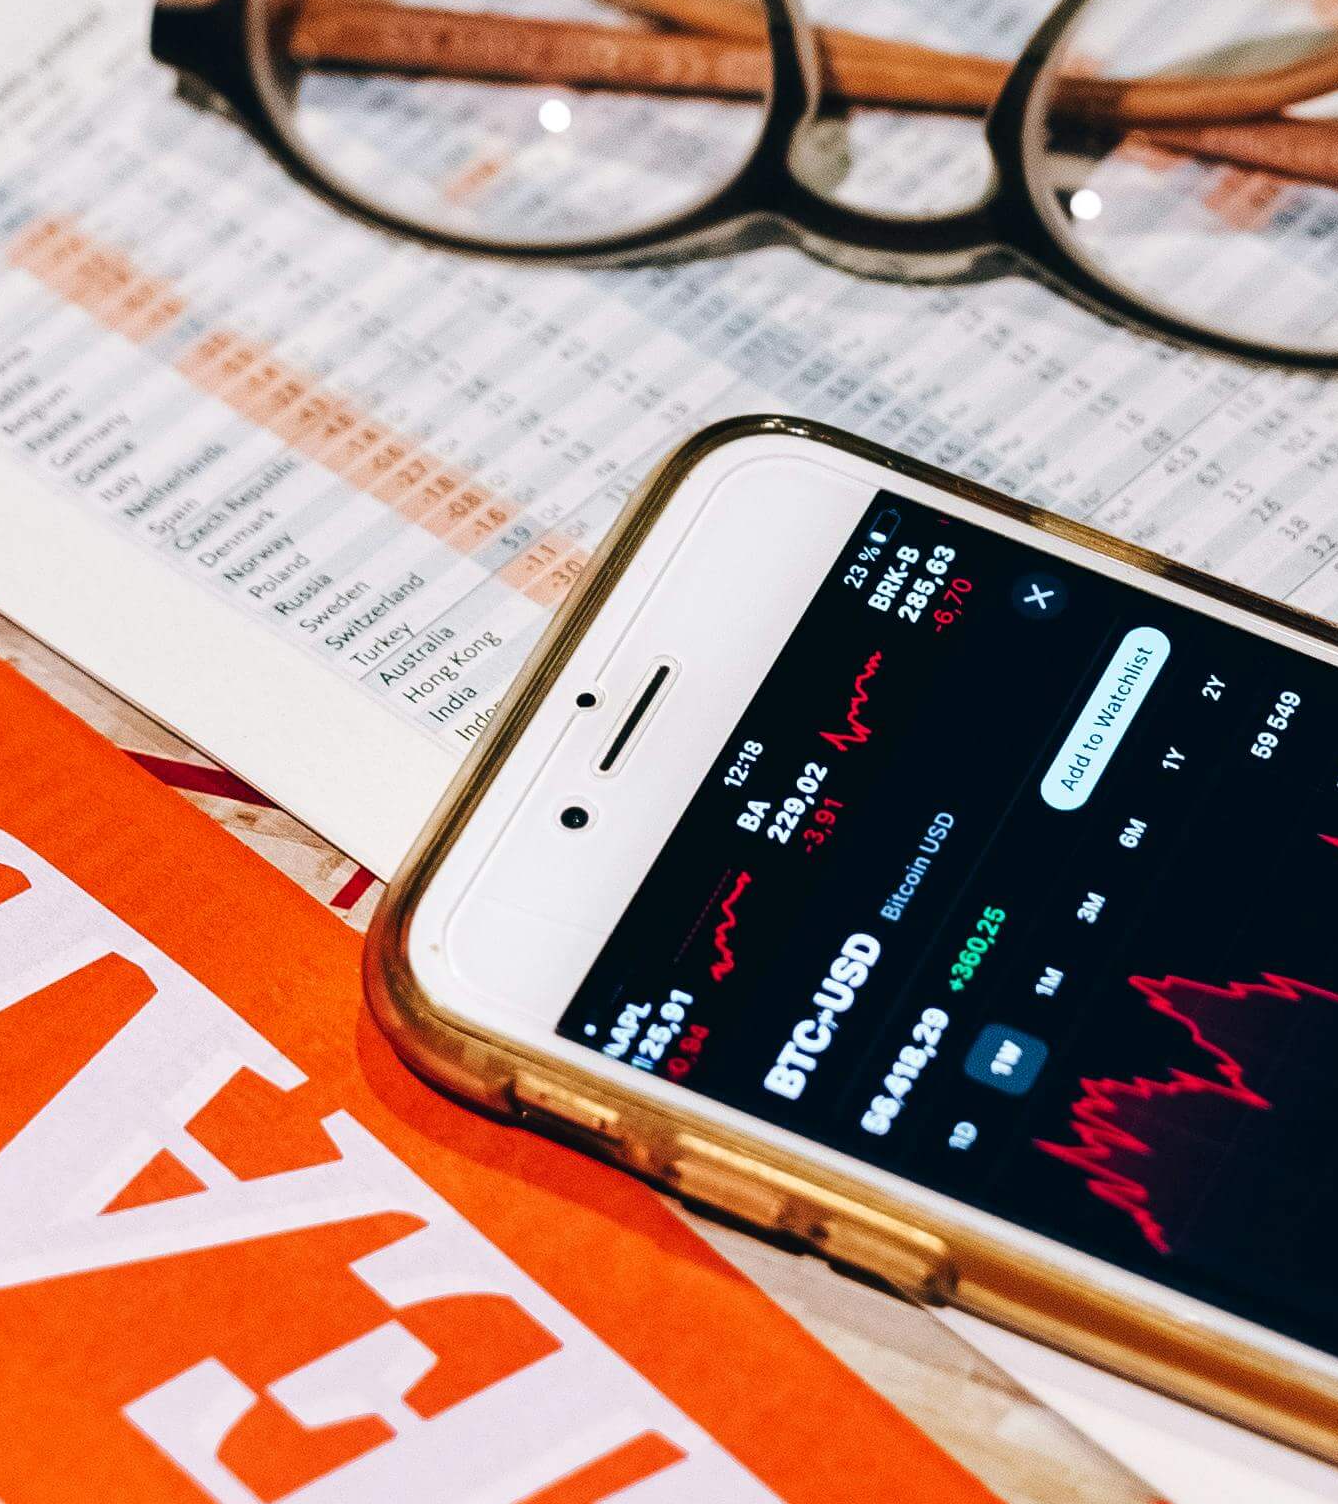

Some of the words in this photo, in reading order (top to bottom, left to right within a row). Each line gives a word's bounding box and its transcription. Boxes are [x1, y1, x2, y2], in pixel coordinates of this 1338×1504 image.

[275, 567, 333, 620] Russia
[299, 574, 370, 637] Sweden
[325, 568, 425, 656] Switzerland
[350, 616, 415, 676] Turkey
[379, 620, 455, 688] Australia
[403, 659, 457, 710] Hong
[449, 624, 502, 674] Kong
[723, 737, 764, 790] 12:18
[843, 562, 868, 589] 23
[858, 542, 881, 565] %
[736, 794, 771, 834] BA
[867, 542, 920, 613] BRK-B
[428, 680, 478, 726] India
[766, 759, 830, 846] 229,02
[897, 542, 959, 626] 285,63
[798, 795, 847, 857] -3,91
[927, 574, 976, 636] -6,70
[1249, 728, 1280, 761] 59
[1265, 687, 1302, 731] 549
[943, 903, 1009, 995] +360,25
[1058, 751, 1092, 791] Add
[1080, 729, 1105, 753] to
[1093, 643, 1153, 731] Watchlist
[763, 928, 883, 1101] BTC-USD
[880, 853, 930, 922] Bitcoin
[920, 810, 955, 855] USD
[946, 1117, 980, 1155] 1D
[988, 1038, 1024, 1080] 1W
[1032, 964, 1065, 1000] 1M
[1075, 889, 1107, 925] 3M
[1117, 816, 1148, 850] 6M
[1160, 746, 1187, 774] 1Y
[1201, 673, 1227, 702] 2Y
